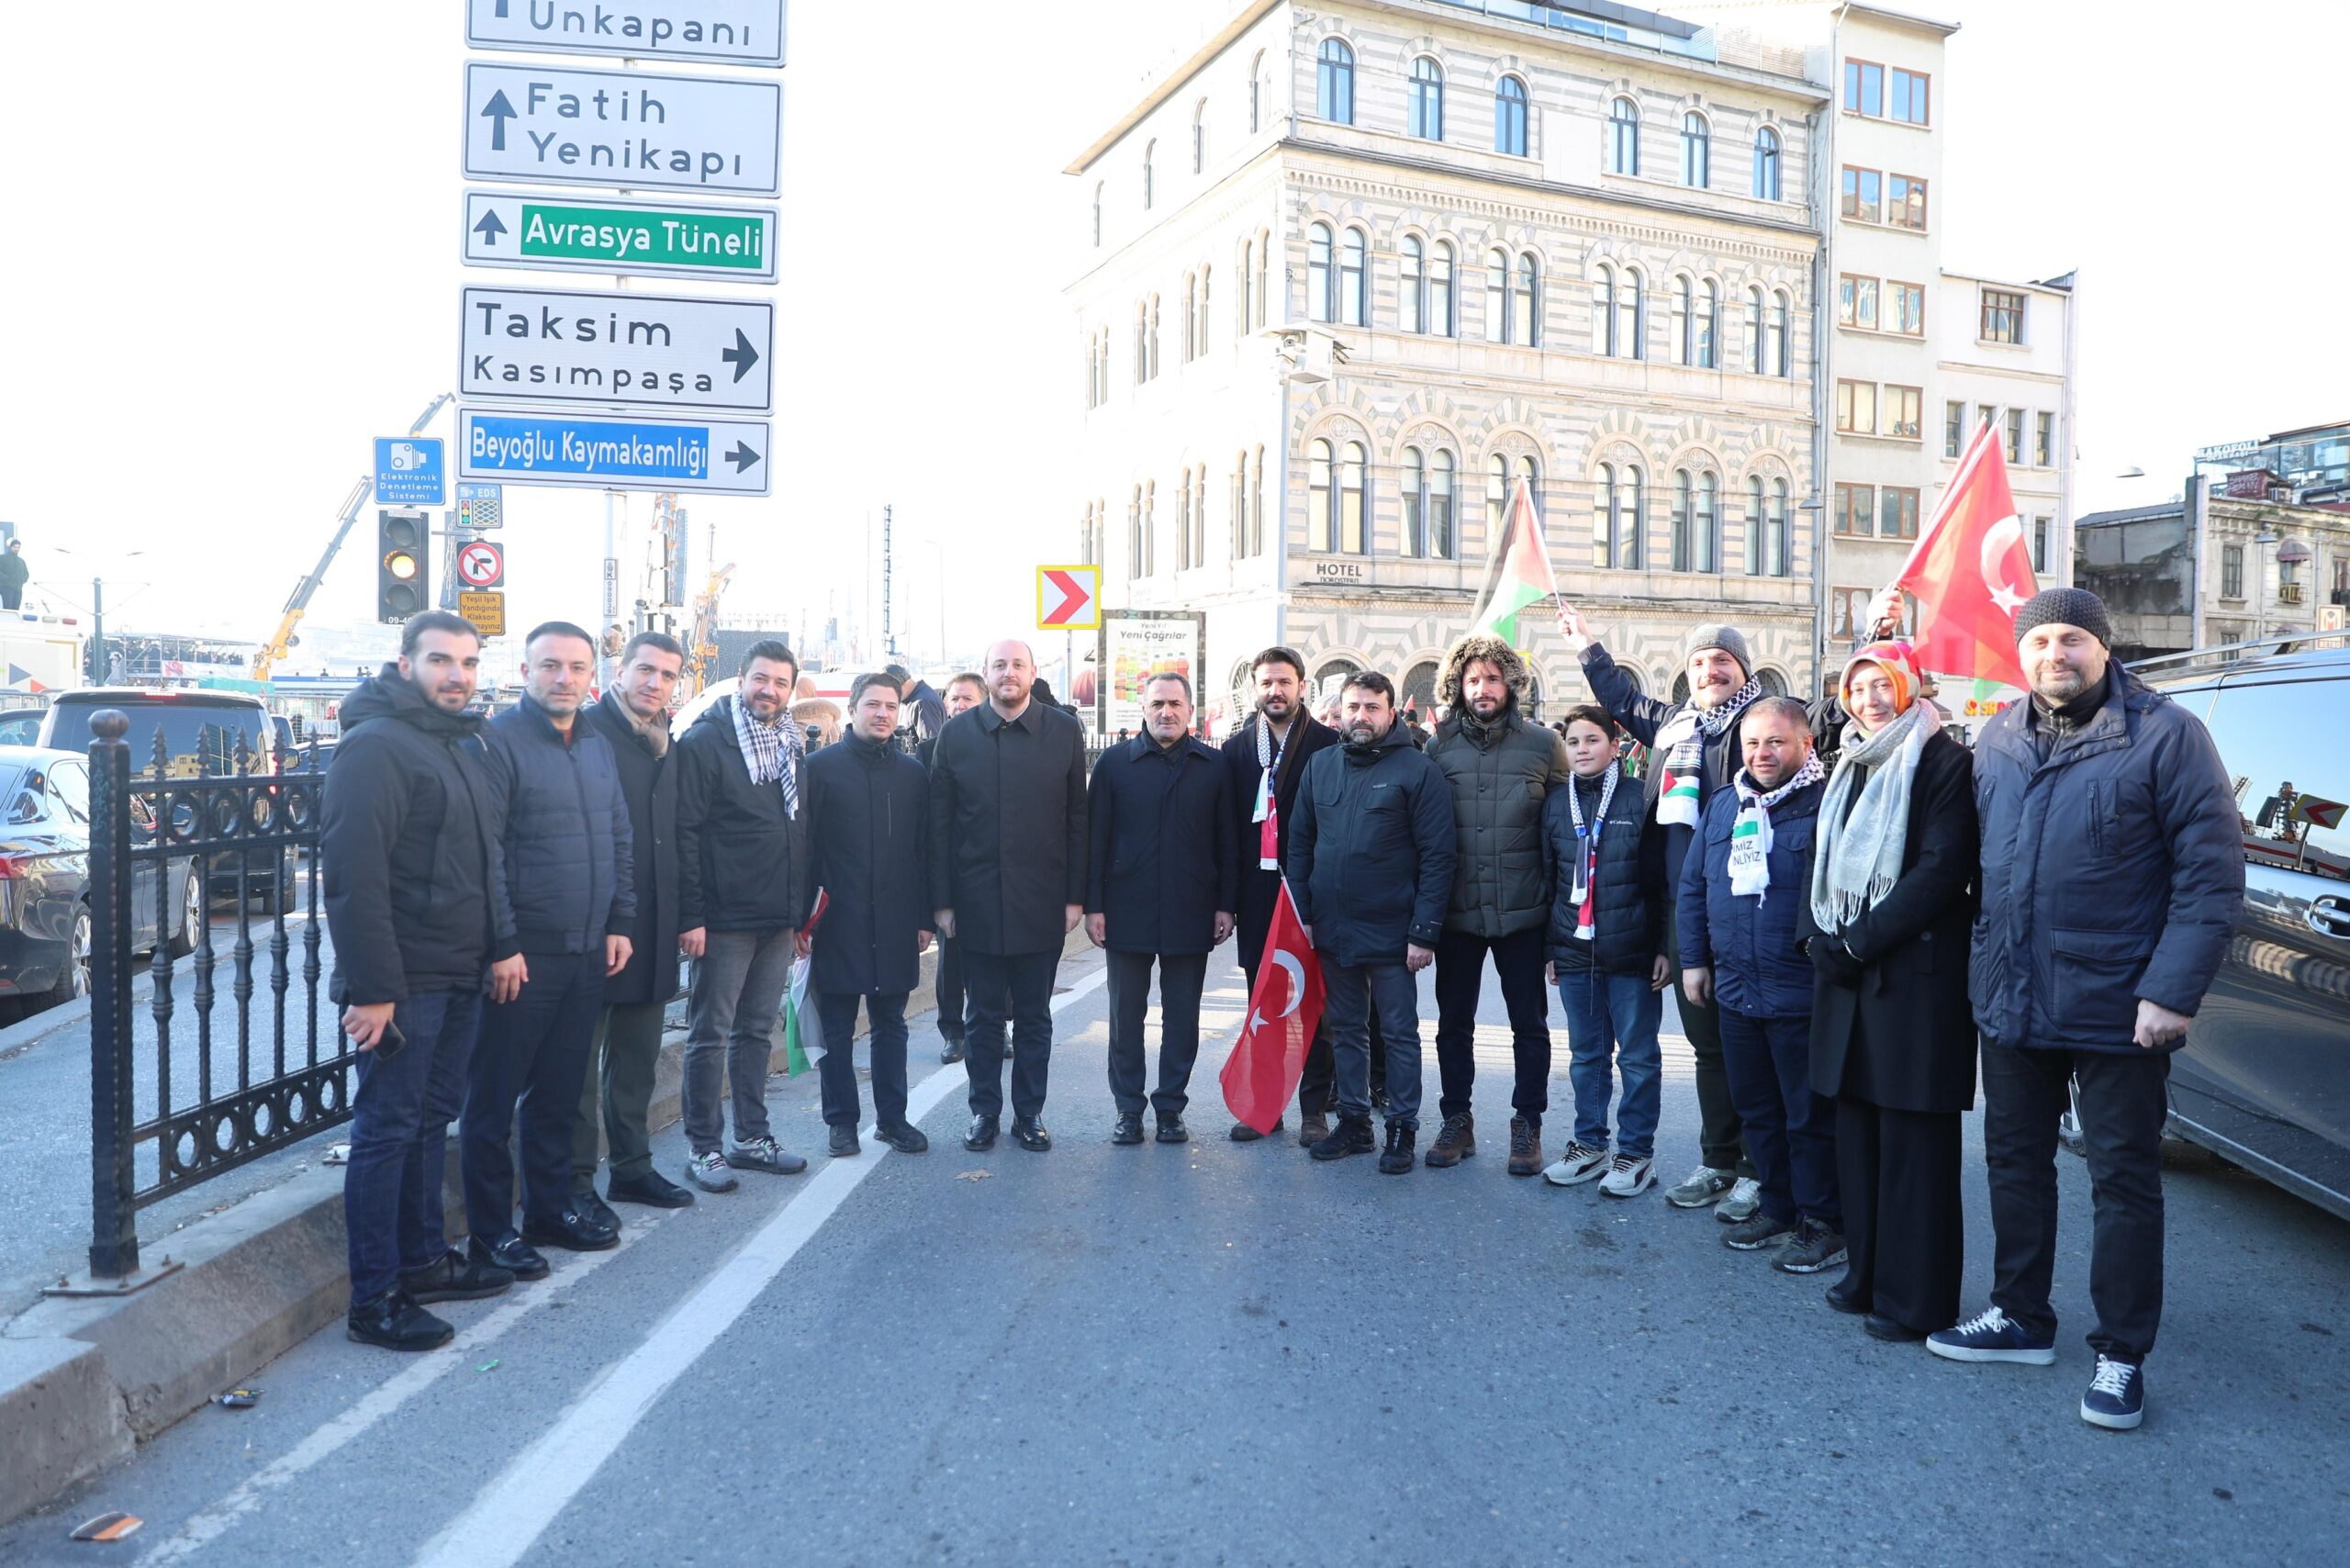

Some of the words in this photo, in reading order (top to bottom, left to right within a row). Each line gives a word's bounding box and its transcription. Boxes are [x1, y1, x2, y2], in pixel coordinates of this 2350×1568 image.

[530, 0, 749, 47] Unkapanı
[528, 83, 665, 123] Fatih
[527, 130, 740, 183] Yenikapı
[525, 213, 650, 257] Avrasya
[662, 220, 760, 256] Tüneli
[476, 302, 671, 346] Taksim
[474, 355, 712, 394] Kasımpaşa
[473, 426, 554, 467] Beyoğlu
[562, 431, 706, 476] Kaymakamlığı
[380, 482, 439, 491] Denetleme
[381, 473, 438, 481] Elektronik
[388, 491, 430, 499] Sistemi
[477, 487, 497, 498] EDS
[1316, 564, 1362, 577] HOTEL
[1120, 631, 1142, 639] Yeni
[1144, 631, 1187, 642] Çağrılar
